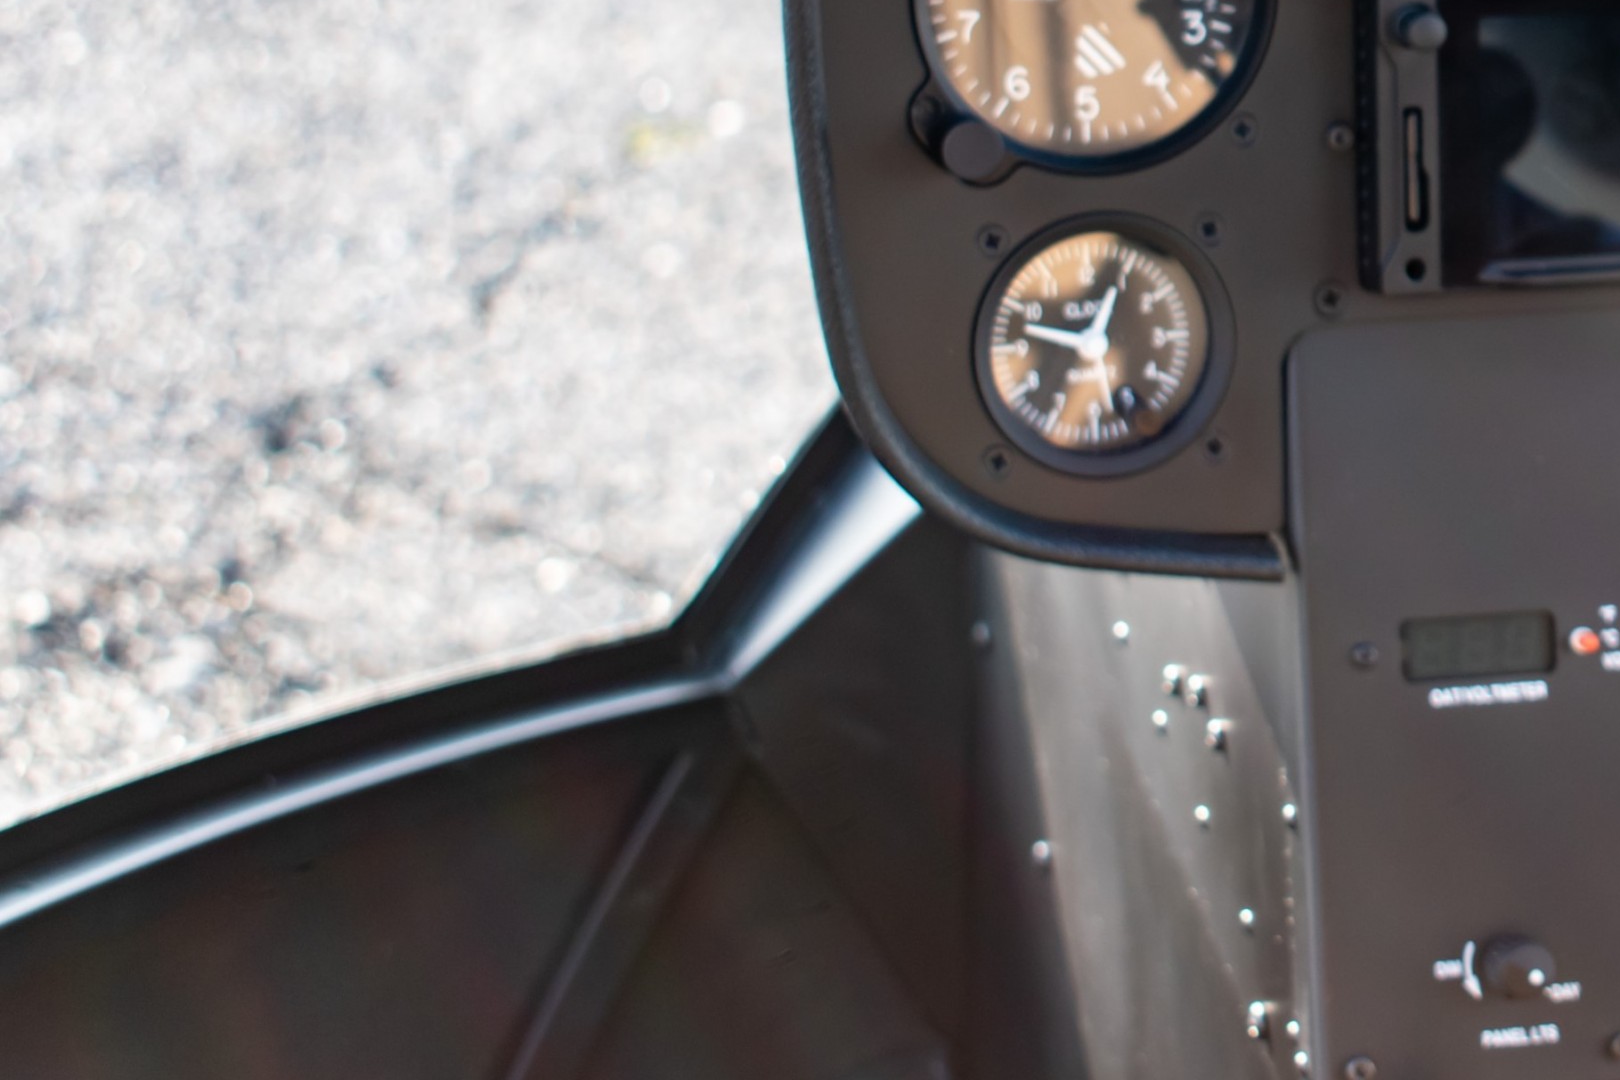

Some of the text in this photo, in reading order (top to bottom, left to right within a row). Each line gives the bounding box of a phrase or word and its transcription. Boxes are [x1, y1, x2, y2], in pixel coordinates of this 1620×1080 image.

[956, 9, 981, 44] 7
[1181, 8, 1206, 46] 3
[1004, 65, 1031, 100] 6
[1074, 85, 1100, 121] 5
